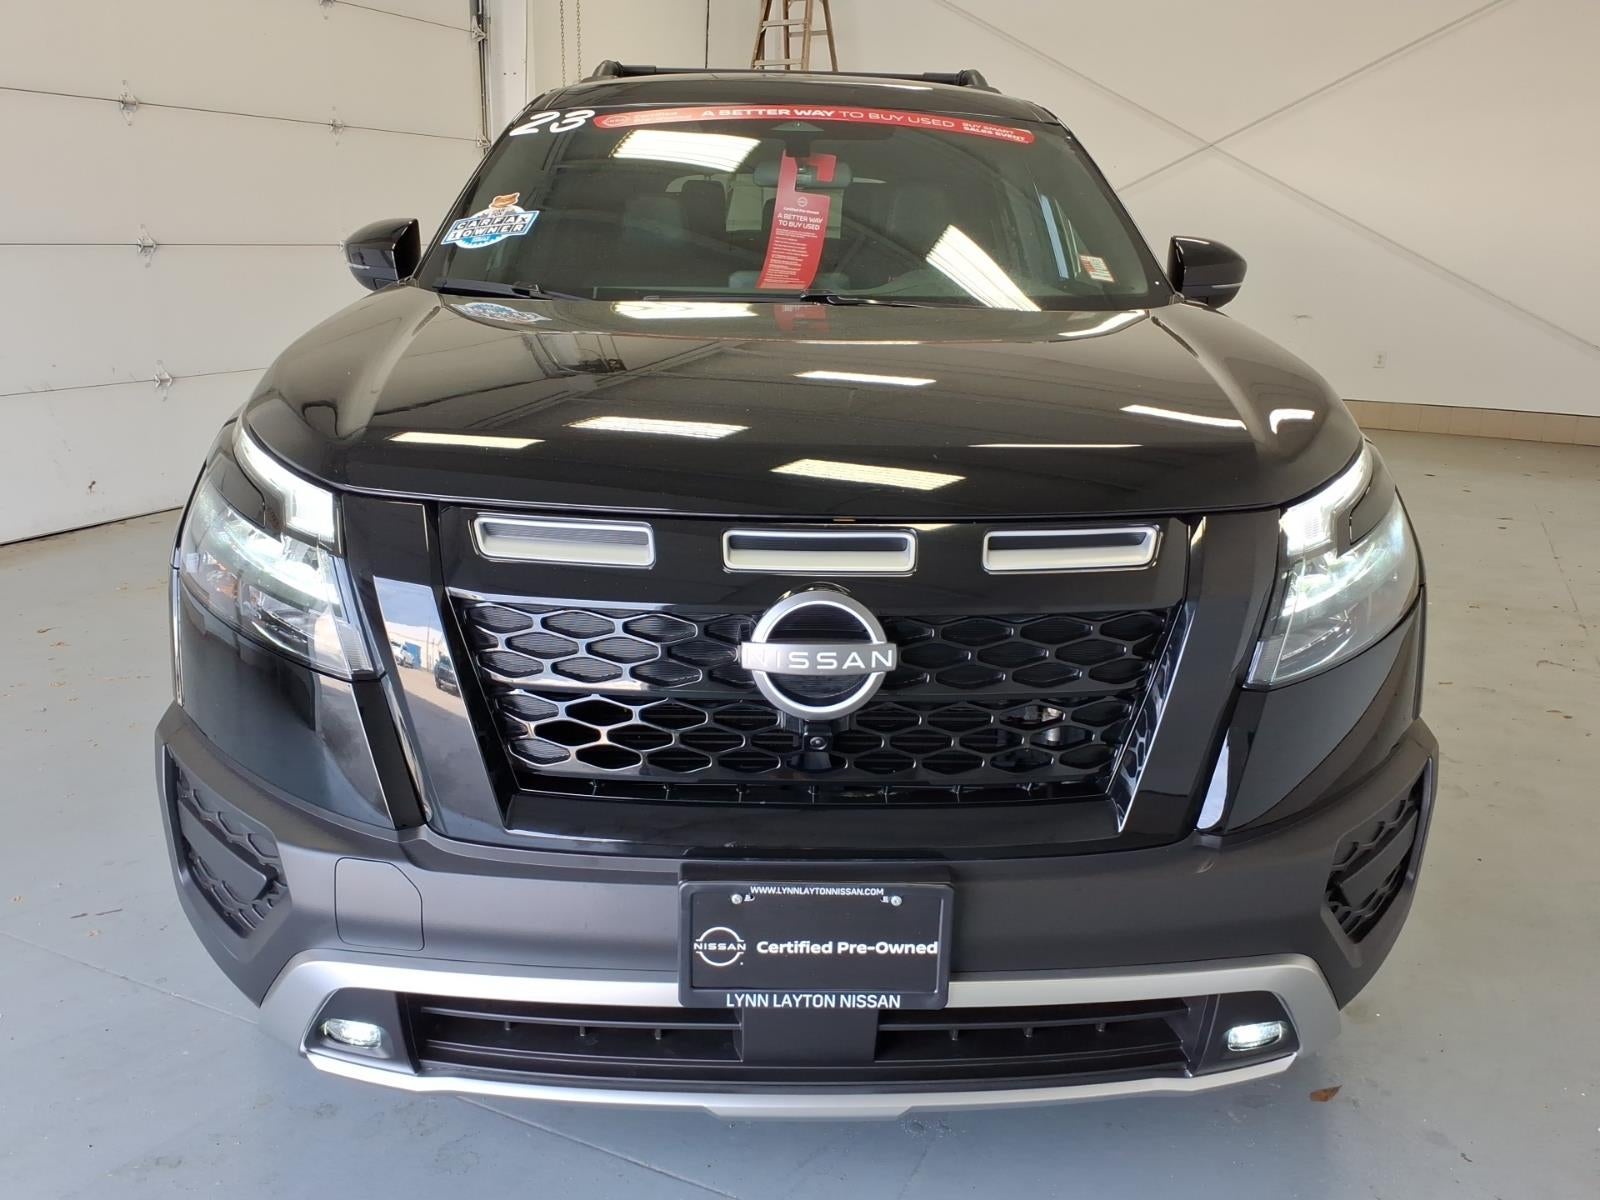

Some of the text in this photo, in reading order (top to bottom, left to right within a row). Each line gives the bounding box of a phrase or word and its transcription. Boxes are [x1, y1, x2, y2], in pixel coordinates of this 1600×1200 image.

[509, 109, 596, 137] 23
[793, 108, 835, 117] WAY
[839, 111, 864, 119] TO
[868, 112, 904, 122] BUY
[908, 115, 955, 128] USED
[962, 126, 1025, 141] SALES EVENT
[983, 125, 1014, 135] SMART
[455, 216, 528, 230] CARFAX
[783, 213, 808, 222] BETTER
[808, 216, 824, 225] WAY
[788, 221, 803, 229] BUY
[803, 223, 820, 231] USED
[746, 649, 894, 670] NISSAN
[750, 886, 884, 896] WWW.LYNNLAYTONNISSAN.COM
[693, 942, 746, 951] NISSAN
[756, 940, 939, 955] Certified Pre-Owned
[726, 993, 902, 1009] LYNN LAYTON NISSAN
